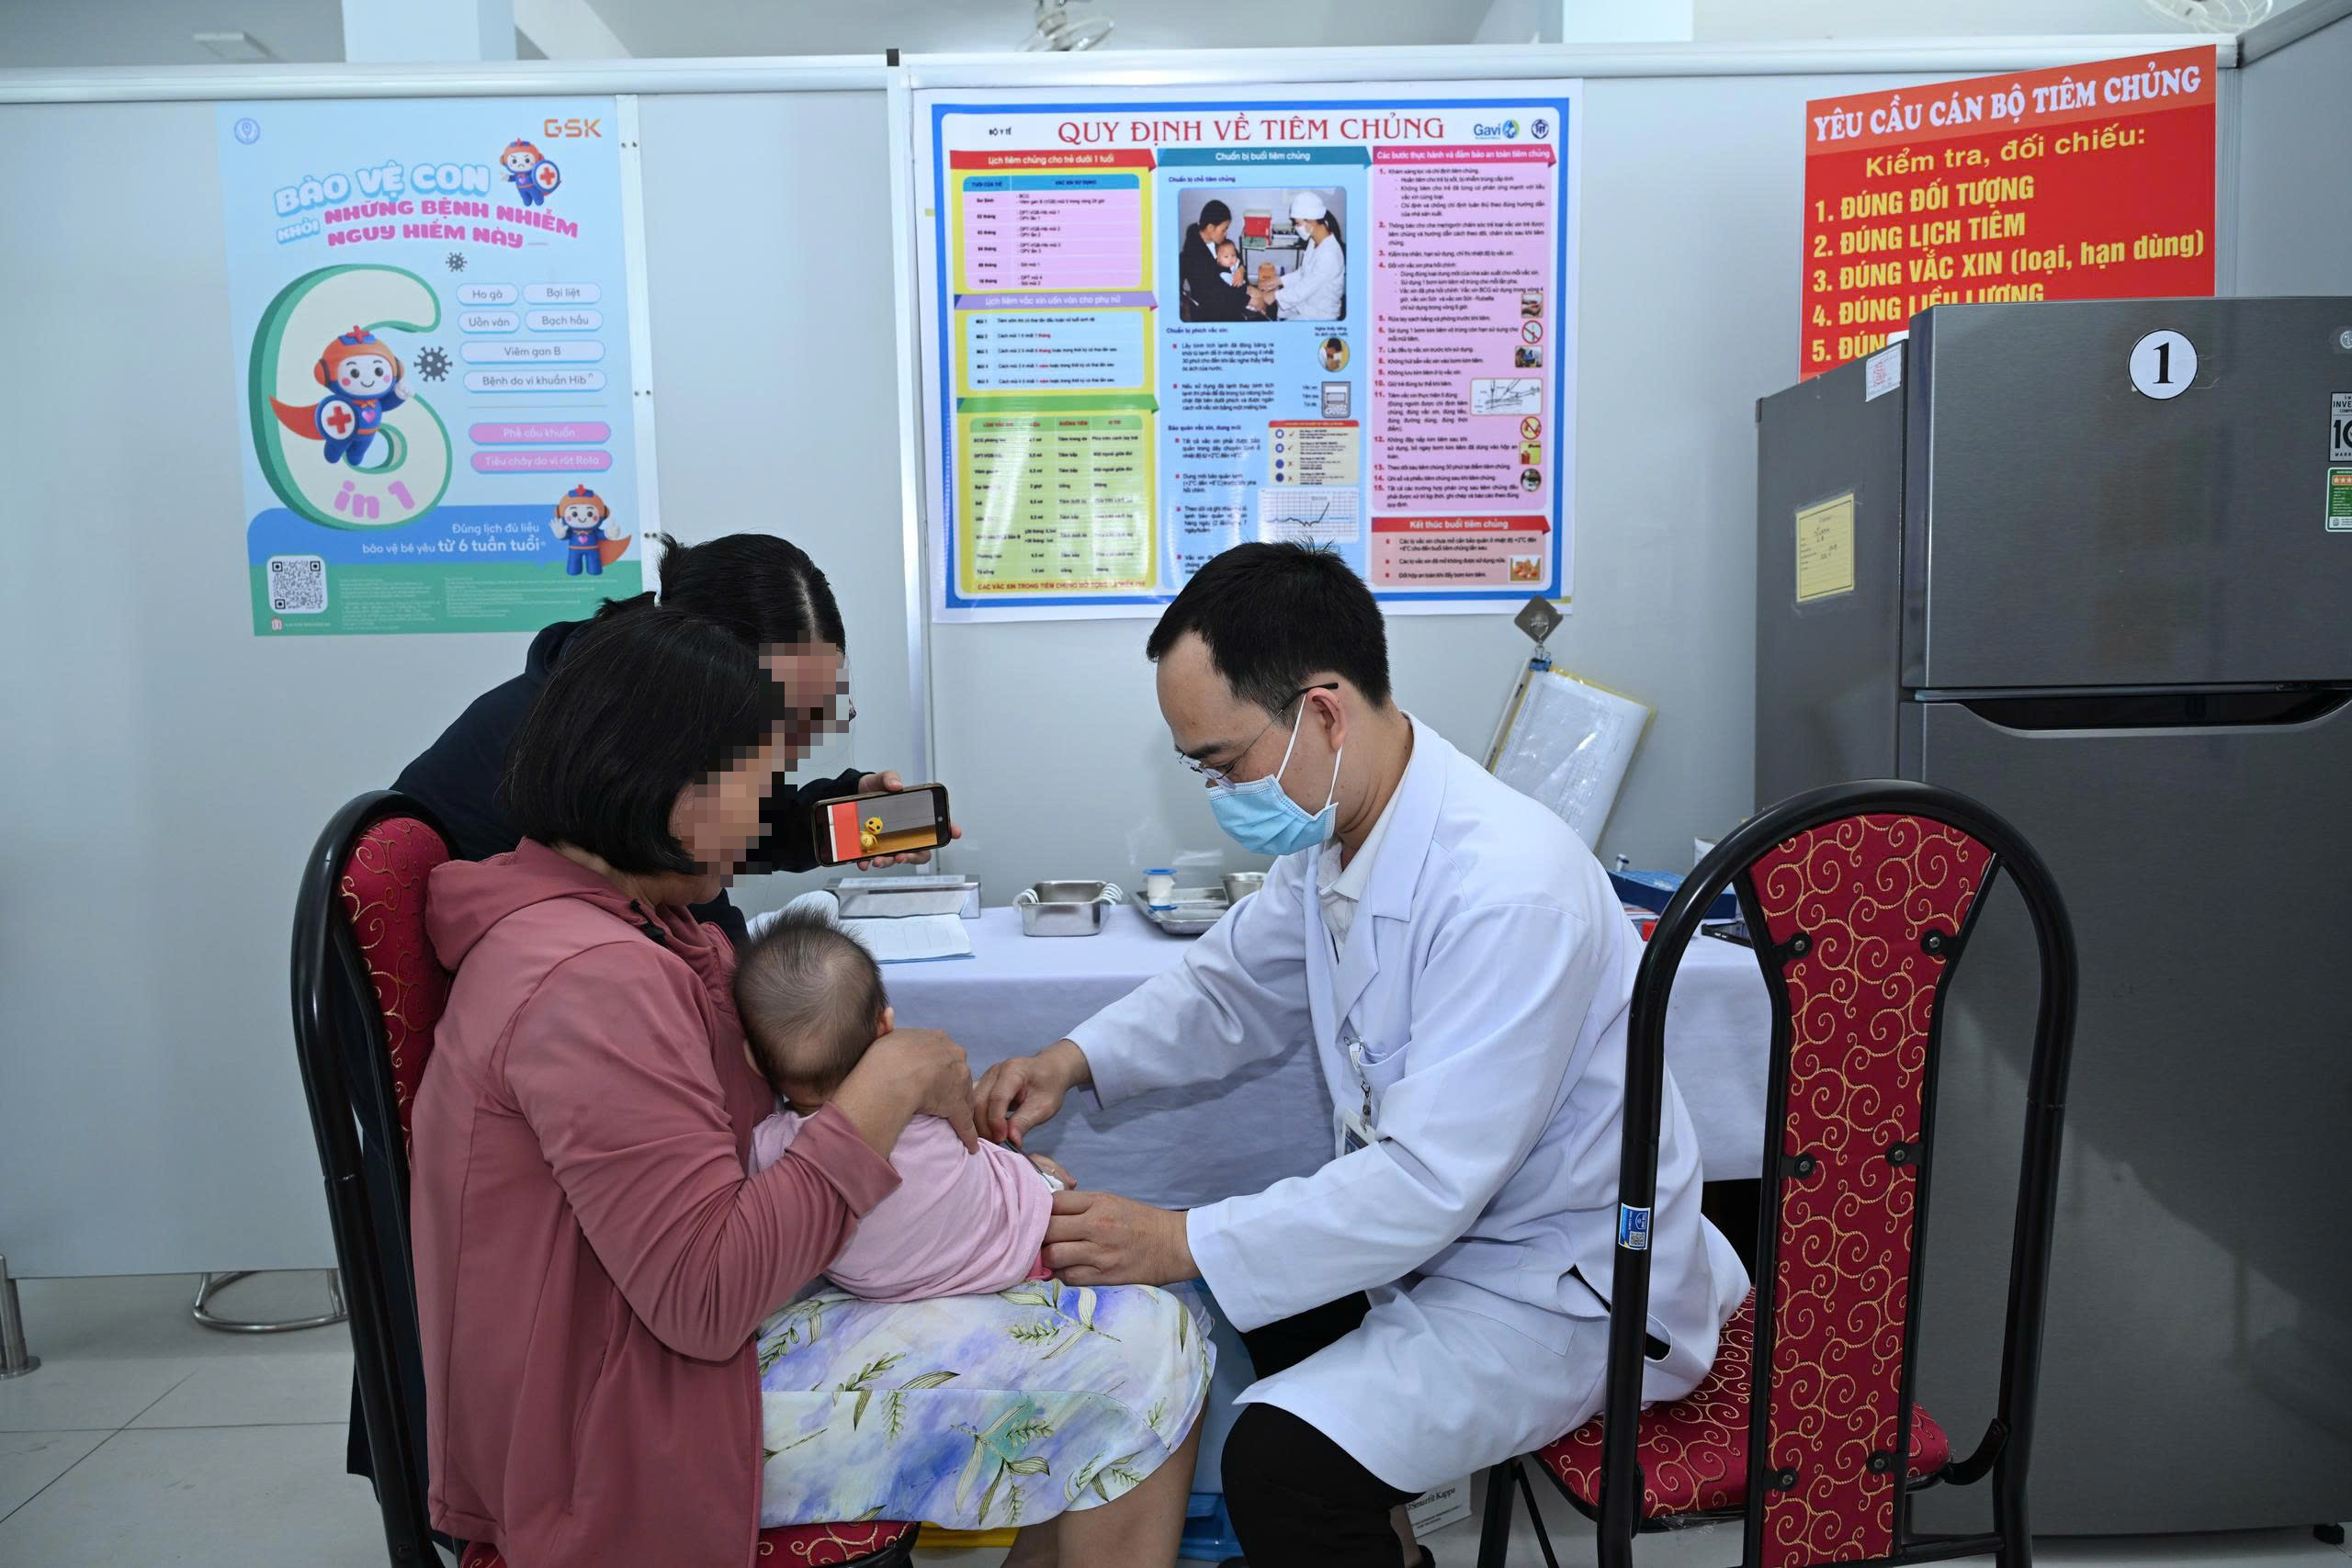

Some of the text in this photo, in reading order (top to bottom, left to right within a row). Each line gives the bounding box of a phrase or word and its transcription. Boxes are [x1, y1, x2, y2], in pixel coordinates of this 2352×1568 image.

[1814, 61, 2201, 141] YÊU CẦU CÁN BỘ TIÊM CHỦNG
[544, 118, 602, 139] GSK
[1057, 111, 1444, 146] QUY ĐỊNH VỀ TIÊM CHỦNG
[1474, 123, 1501, 136] Gavi
[1004, 154, 1022, 164] tiêm
[1023, 153, 1046, 165] chủng
[1047, 154, 1062, 164] cho
[1063, 154, 1074, 164] trẻ
[1075, 153, 1092, 164] dưới
[1093, 154, 1098, 164] 1
[1100, 152, 1114, 164] tuổi
[1216, 150, 1311, 162] Chuẩn bị buổi tiêm chủng
[1528, 148, 1550, 159] chủng
[1866, 123, 2145, 178] Kiểm tra, đối chiếu:
[275, 161, 491, 217] BẢO VỆ CON
[1815, 175, 2034, 223] 1. ĐÚNG ĐỐI TƯỢNG
[324, 196, 579, 239] NHỮNG BỆNH NHIỄM
[327, 217, 524, 249] NGUY HIỂM NÀY
[1814, 211, 2026, 258] 2. ĐÚNG LỊCH TIÊM
[1813, 229, 2205, 293] 3. ĐÚNG VẮC XIN (loại, hạn dùng)
[472, 288, 503, 301] Ho gà
[546, 287, 581, 299] Bại liệt
[1079, 296, 1093, 304] cho
[1812, 304, 1832, 327] 4.
[1838, 294, 1902, 326] ĐÚNG
[492, 317, 511, 327] ván
[542, 315, 567, 327] Bạch
[504, 345, 561, 358] Viêm gan B
[1812, 330, 1886, 363] 5. ĐÚN
[2152, 343, 2172, 385] 1
[482, 376, 508, 388] Bệnh
[510, 376, 524, 386] do
[526, 376, 534, 386] vi
[569, 375, 586, 386] Hib
[334, 479, 379, 520] in
[388, 479, 416, 510] 1
[452, 523, 481, 536] Đúng
[483, 523, 503, 535] lịch
[1483, 518, 1509, 529] chủng
[437, 538, 455, 552] từ
[458, 538, 469, 552] 6
[471, 535, 506, 552] tuần
[510, 534, 540, 552] tuổi
